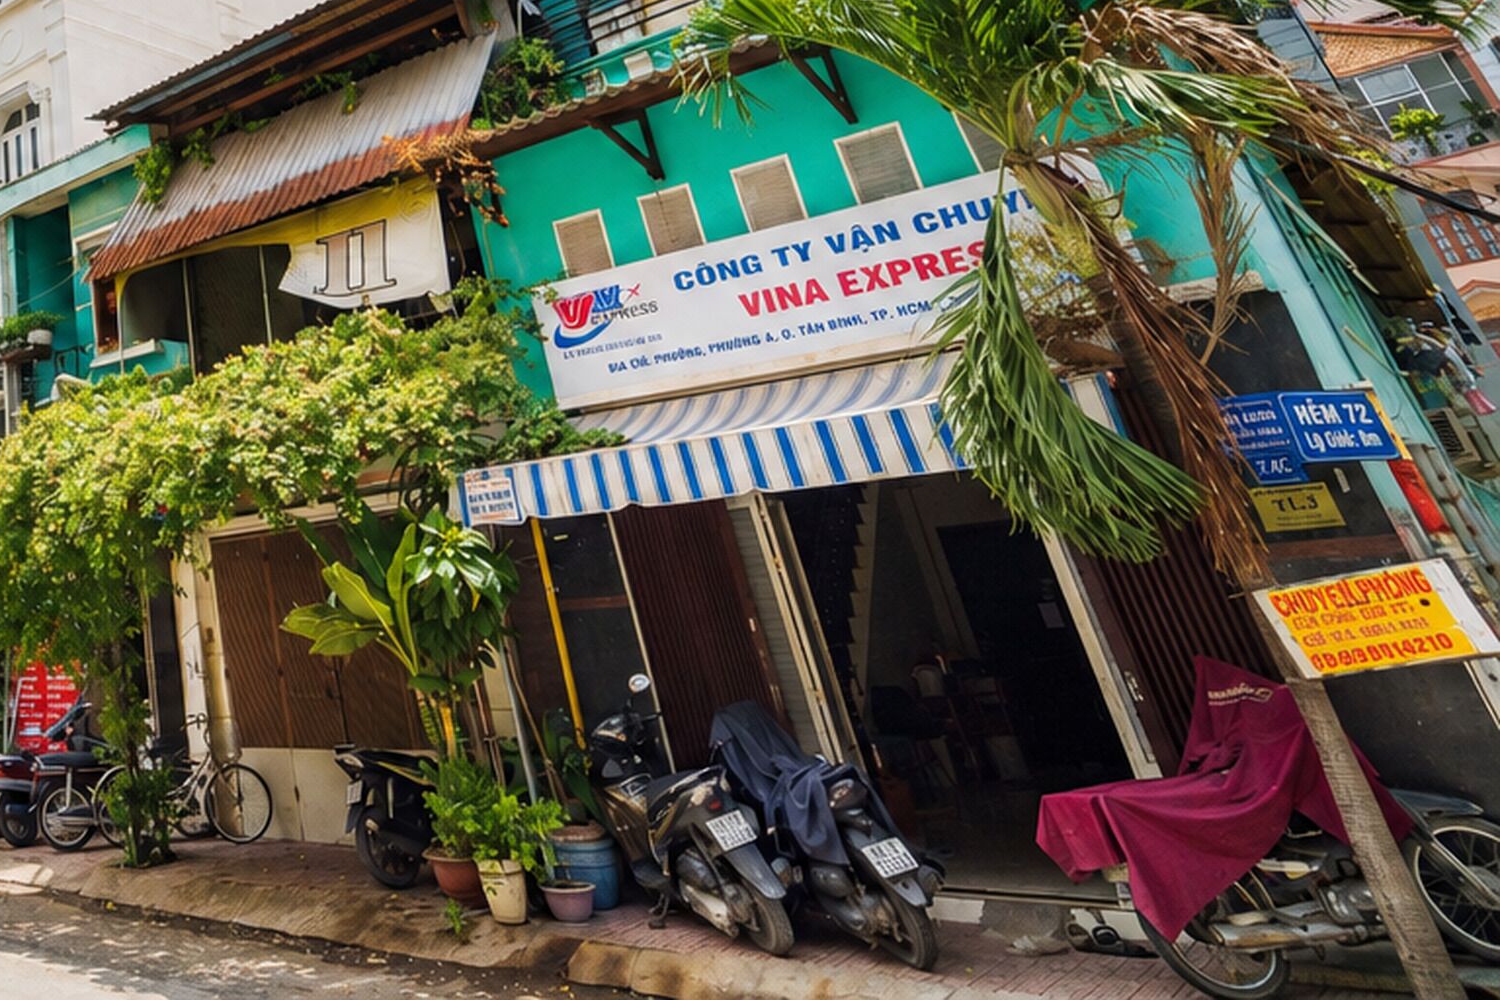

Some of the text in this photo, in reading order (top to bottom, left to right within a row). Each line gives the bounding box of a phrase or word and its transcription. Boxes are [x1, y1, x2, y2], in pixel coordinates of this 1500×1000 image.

[673, 255, 763, 291] CÔNG
[771, 241, 811, 267] TY
[824, 220, 901, 254] VẬN
[738, 279, 830, 317] VINA
[1341, 403, 1373, 425] 72
